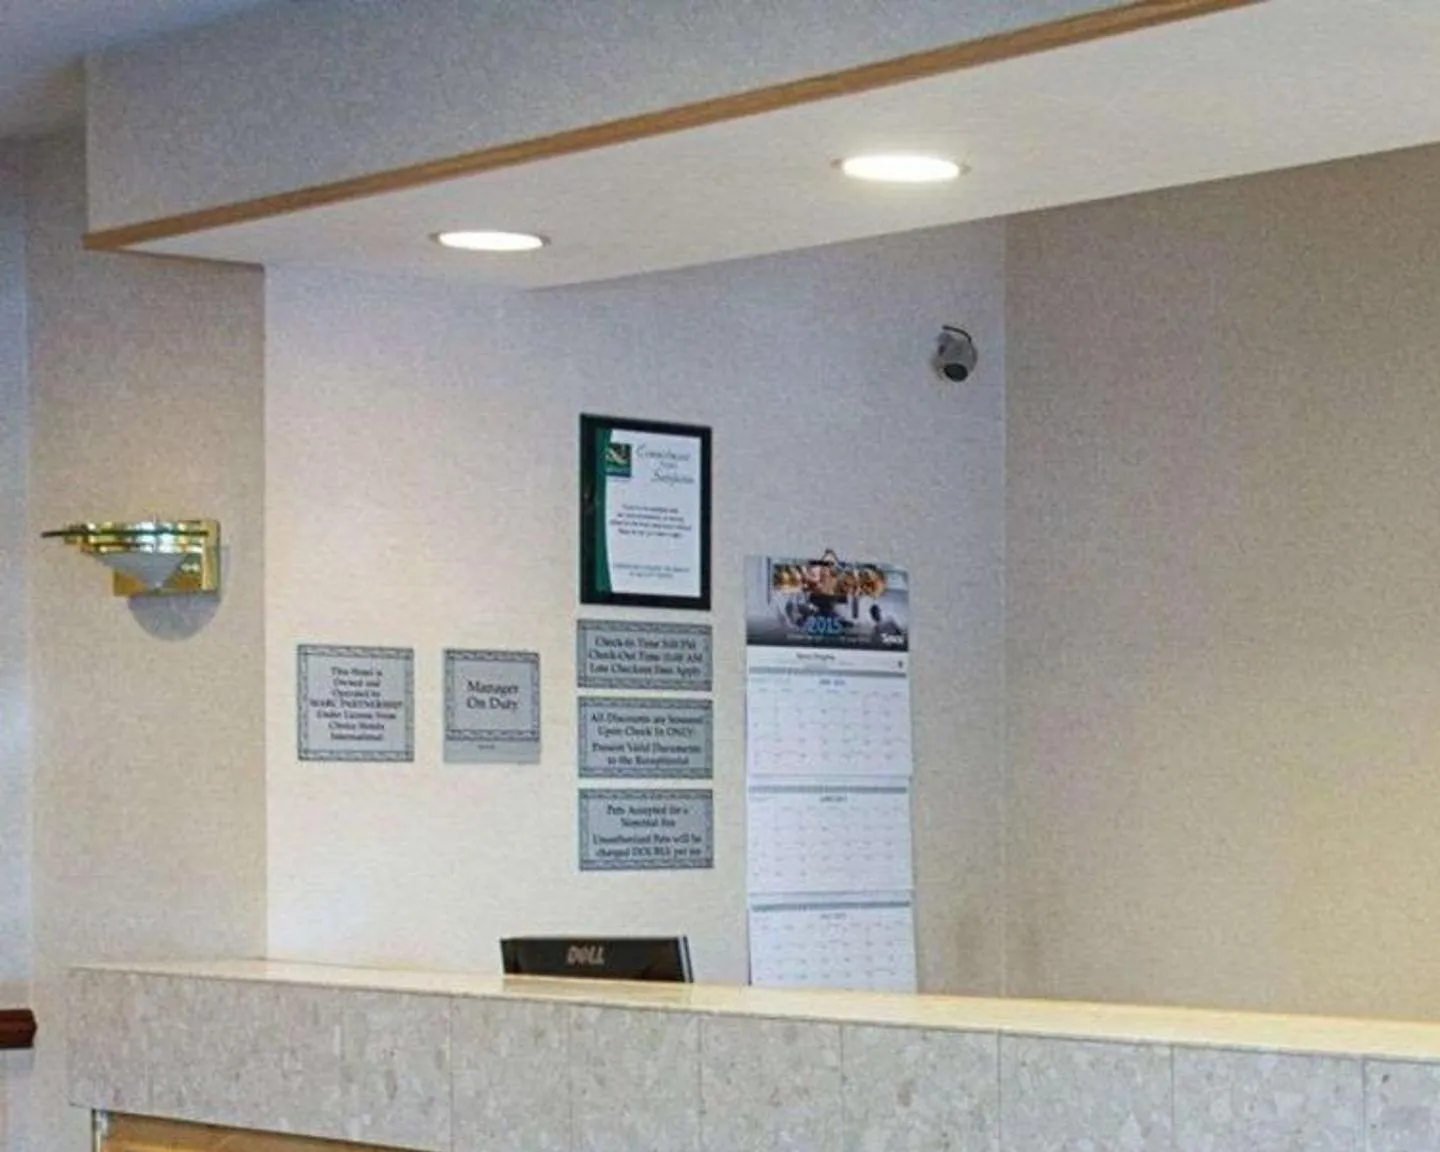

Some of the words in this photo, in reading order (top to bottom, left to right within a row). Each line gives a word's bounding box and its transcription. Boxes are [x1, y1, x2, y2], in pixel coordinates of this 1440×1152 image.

[806, 615, 844, 634] 2015
[466, 680, 519, 698] Manager
[466, 696, 487, 710] On
[489, 696, 519, 713] Duty
